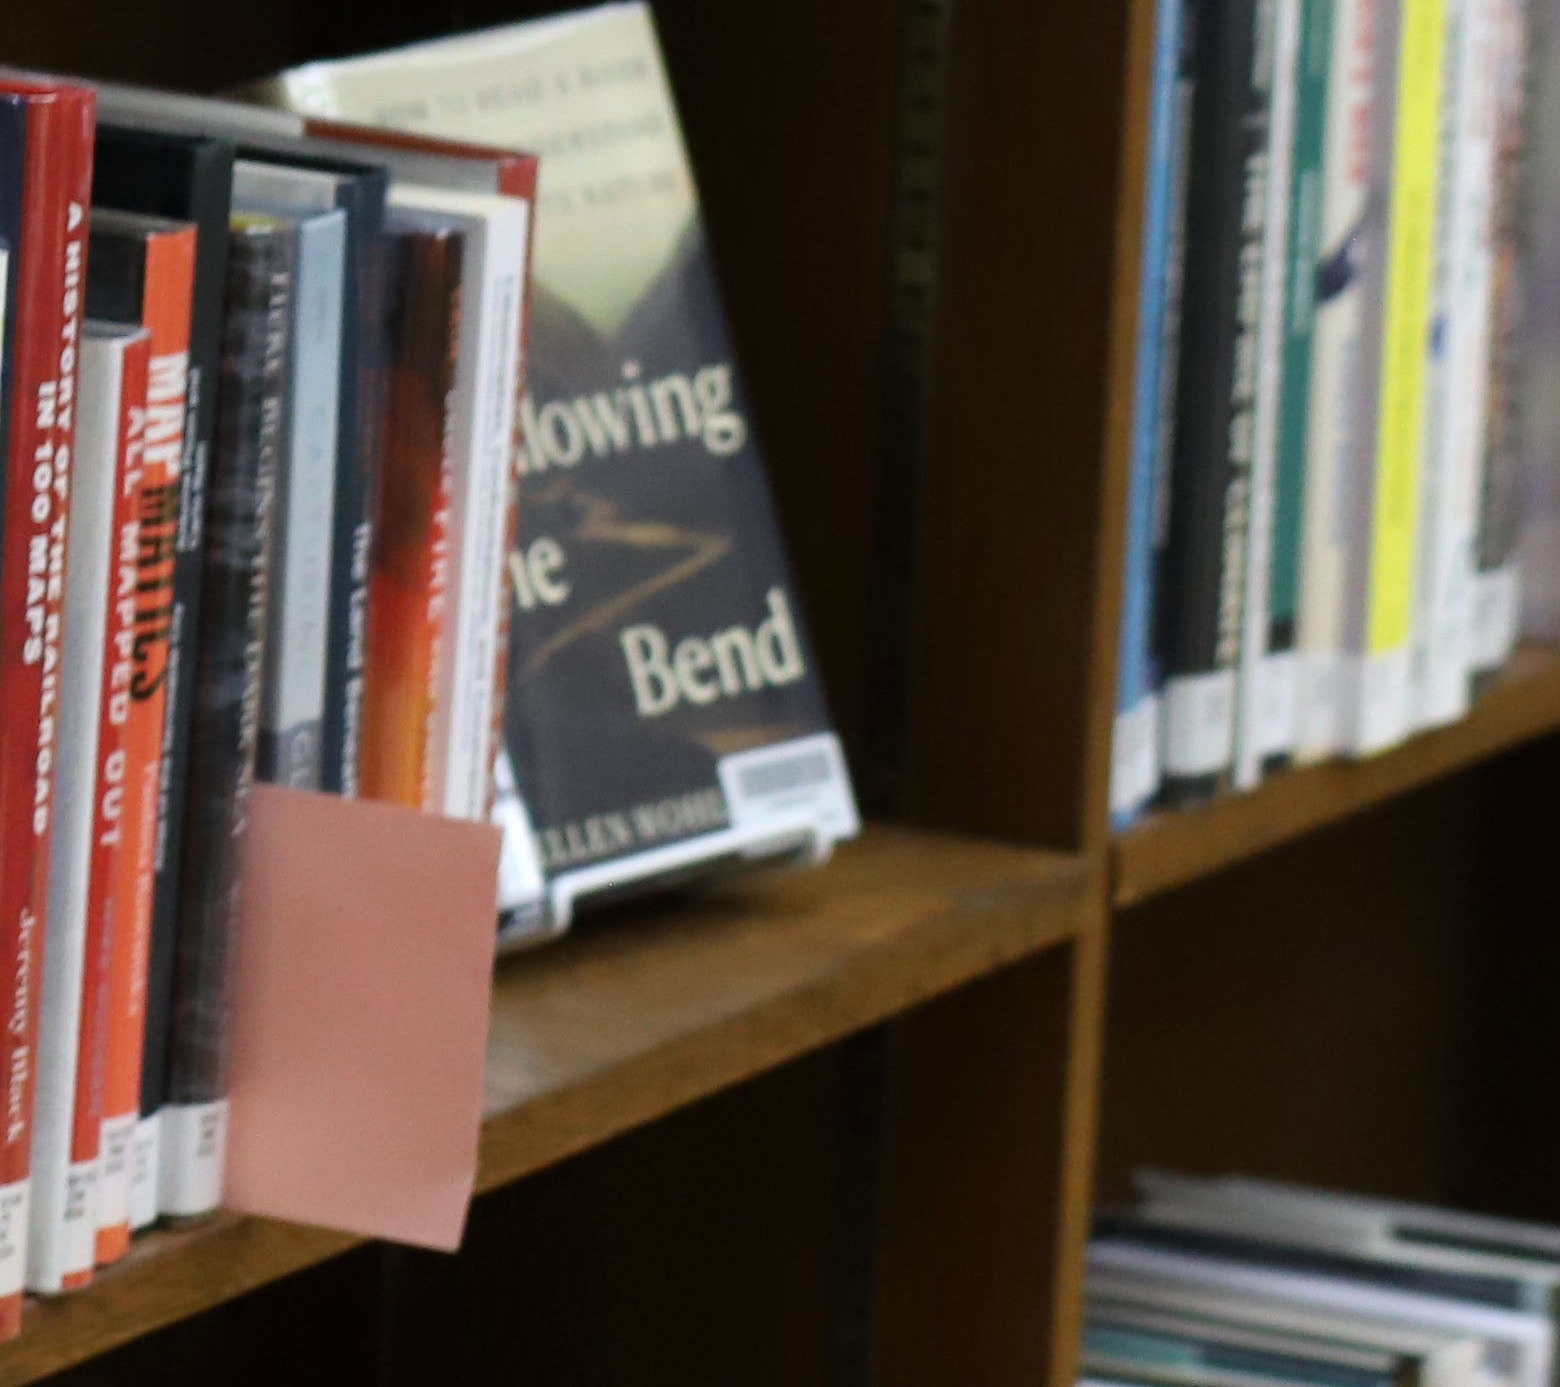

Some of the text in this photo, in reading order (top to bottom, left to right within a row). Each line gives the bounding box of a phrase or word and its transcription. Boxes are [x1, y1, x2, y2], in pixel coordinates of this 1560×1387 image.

[23, 381, 56, 666] IN 100 MAPS
[33, 202, 82, 836] A HISTORY OF THE RAILROAD
[516, 360, 746, 476] lowing
[101, 406, 144, 846] ALL MAPPED OUT
[620, 586, 805, 717] Bend
